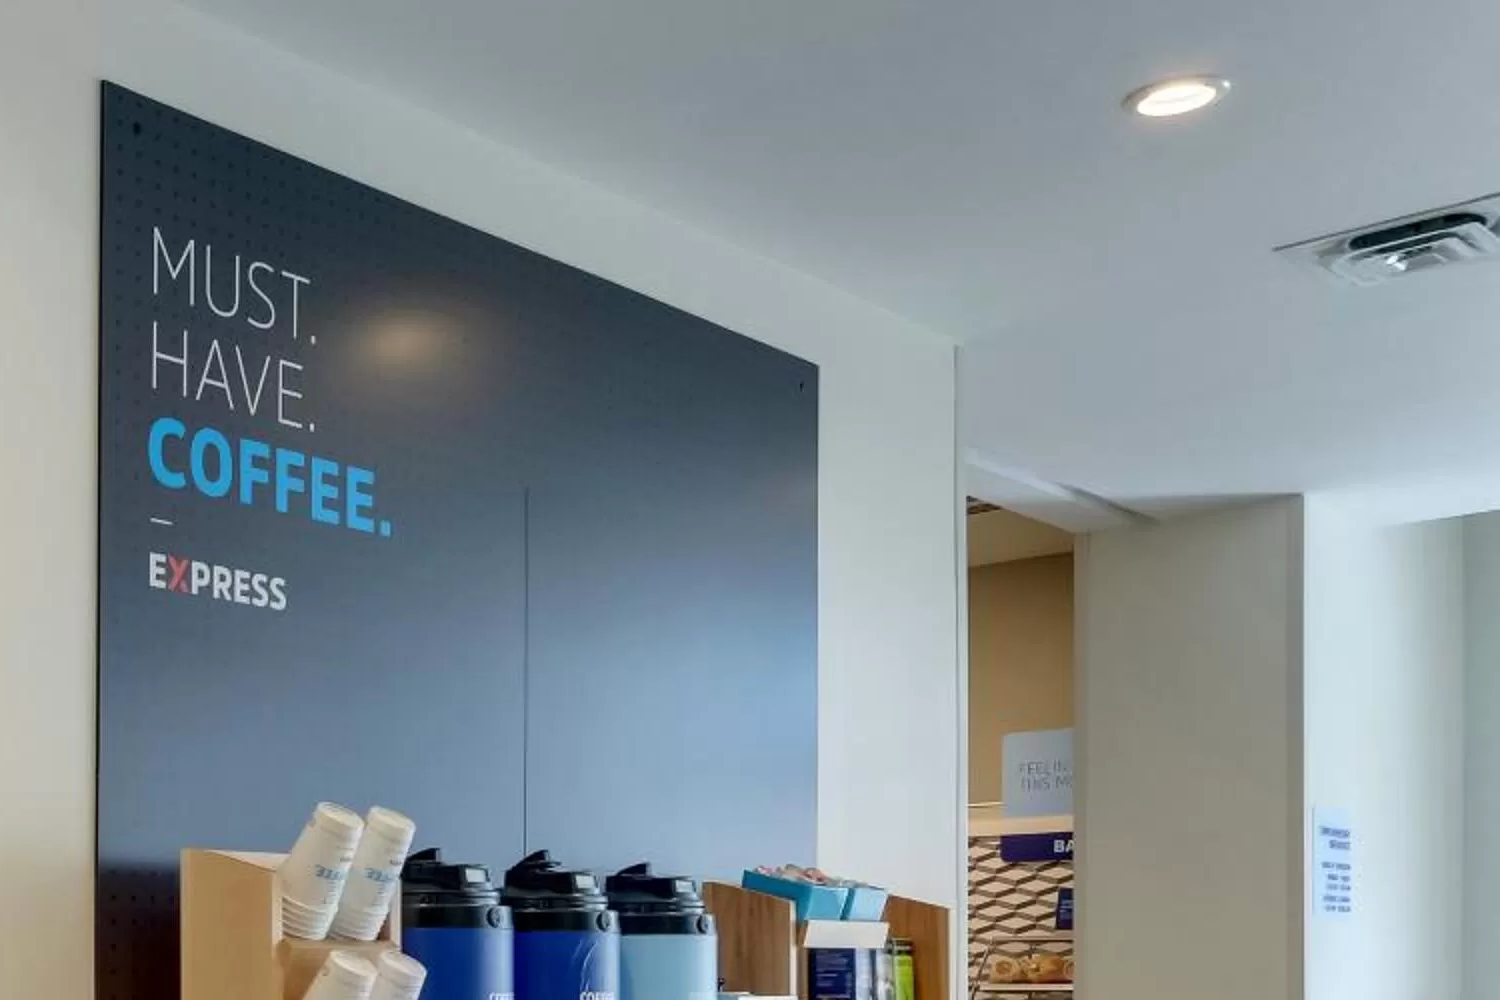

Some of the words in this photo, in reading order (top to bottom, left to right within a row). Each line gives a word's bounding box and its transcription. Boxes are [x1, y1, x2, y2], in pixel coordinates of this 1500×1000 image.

[153, 226, 317, 346] MUST.
[152, 321, 316, 432] HAVE.
[147, 416, 392, 537] COFFEE.
[149, 552, 288, 611] EXPRESS
[1053, 839, 1076, 854] BA
